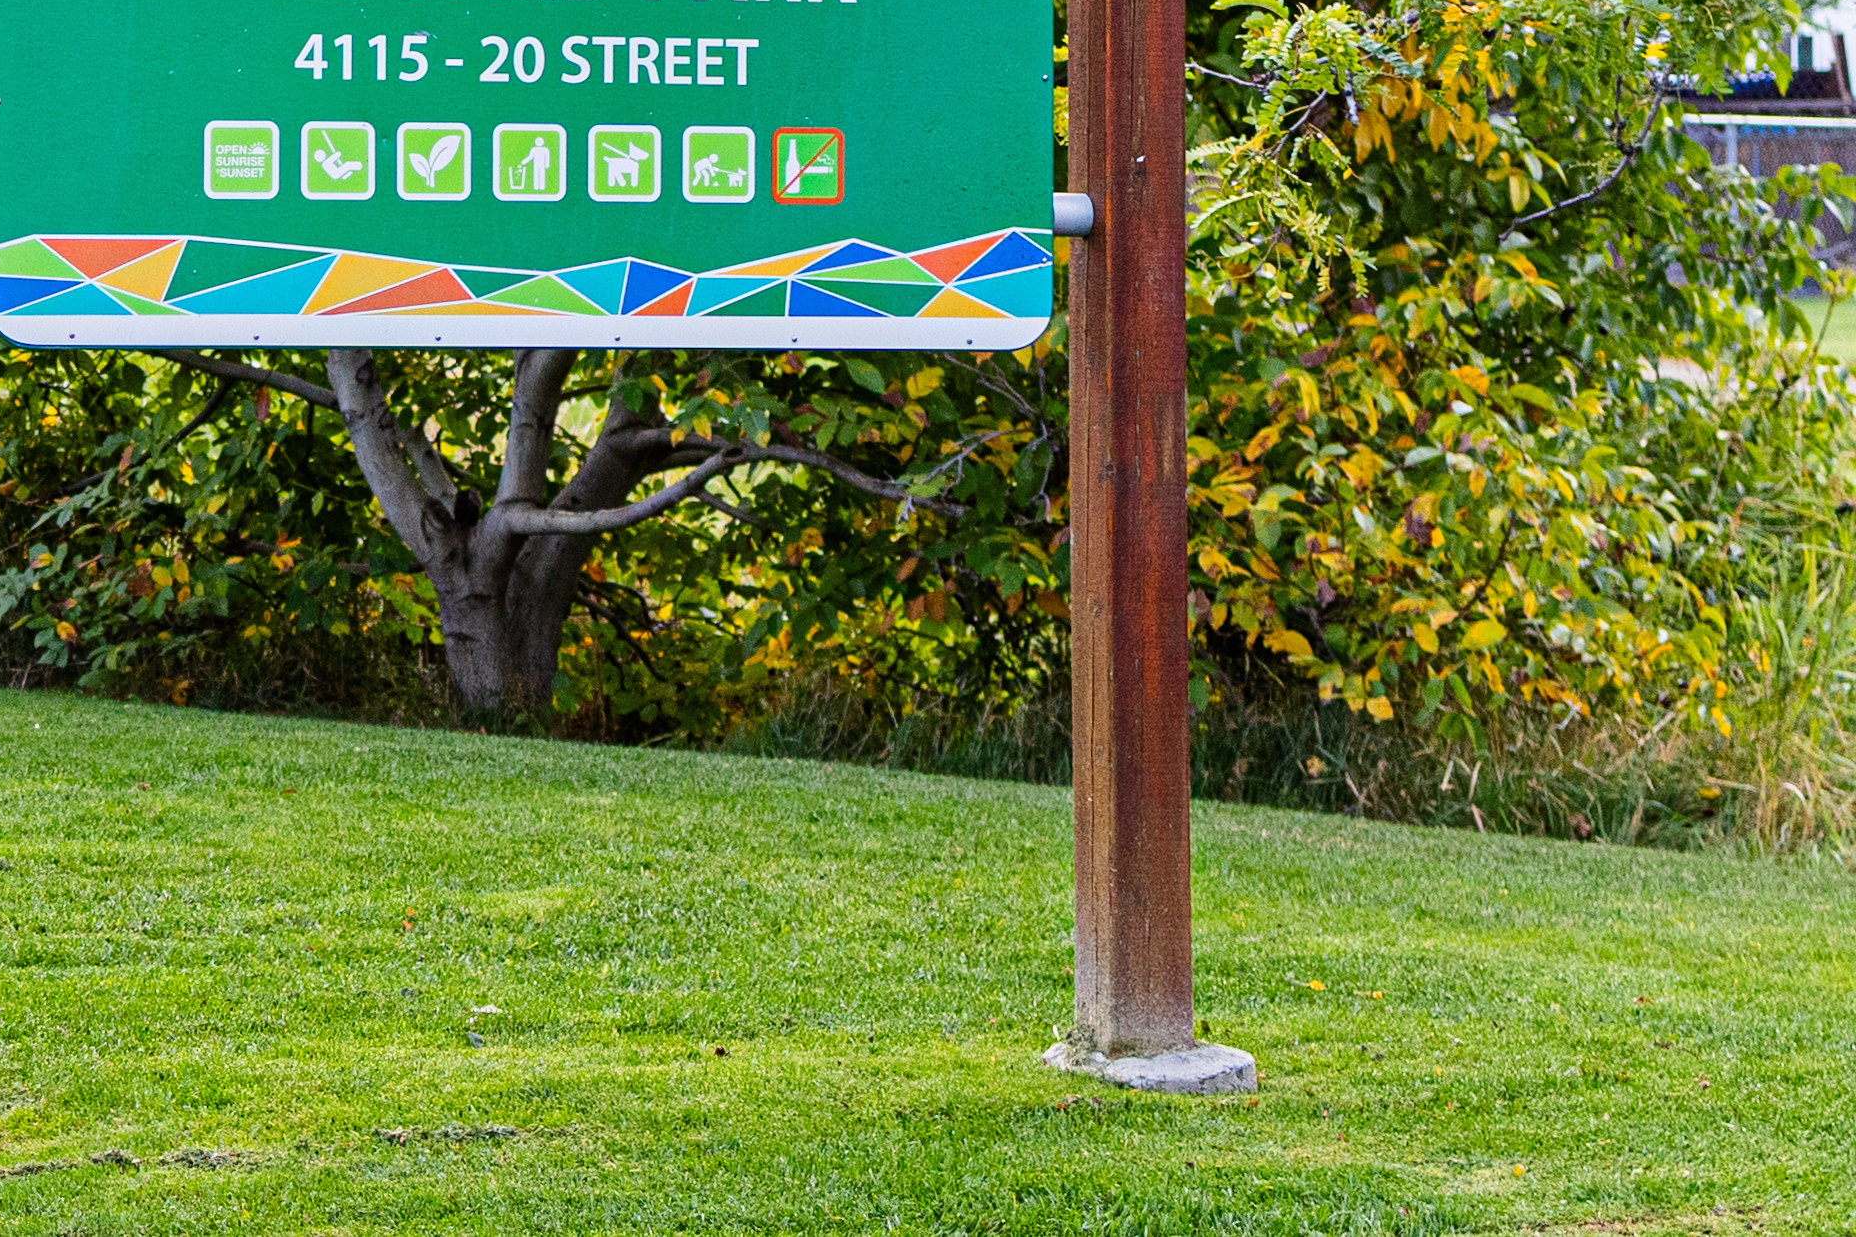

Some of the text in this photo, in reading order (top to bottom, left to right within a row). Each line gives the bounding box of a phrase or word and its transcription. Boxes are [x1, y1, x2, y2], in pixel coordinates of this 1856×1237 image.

[294, 33, 430, 82] 4115
[479, 35, 546, 84] 20
[560, 36, 760, 86] STREET
[215, 144, 248, 155] OPEN
[215, 156, 266, 167] SUNRISE
[219, 168, 266, 178] SUNSET
